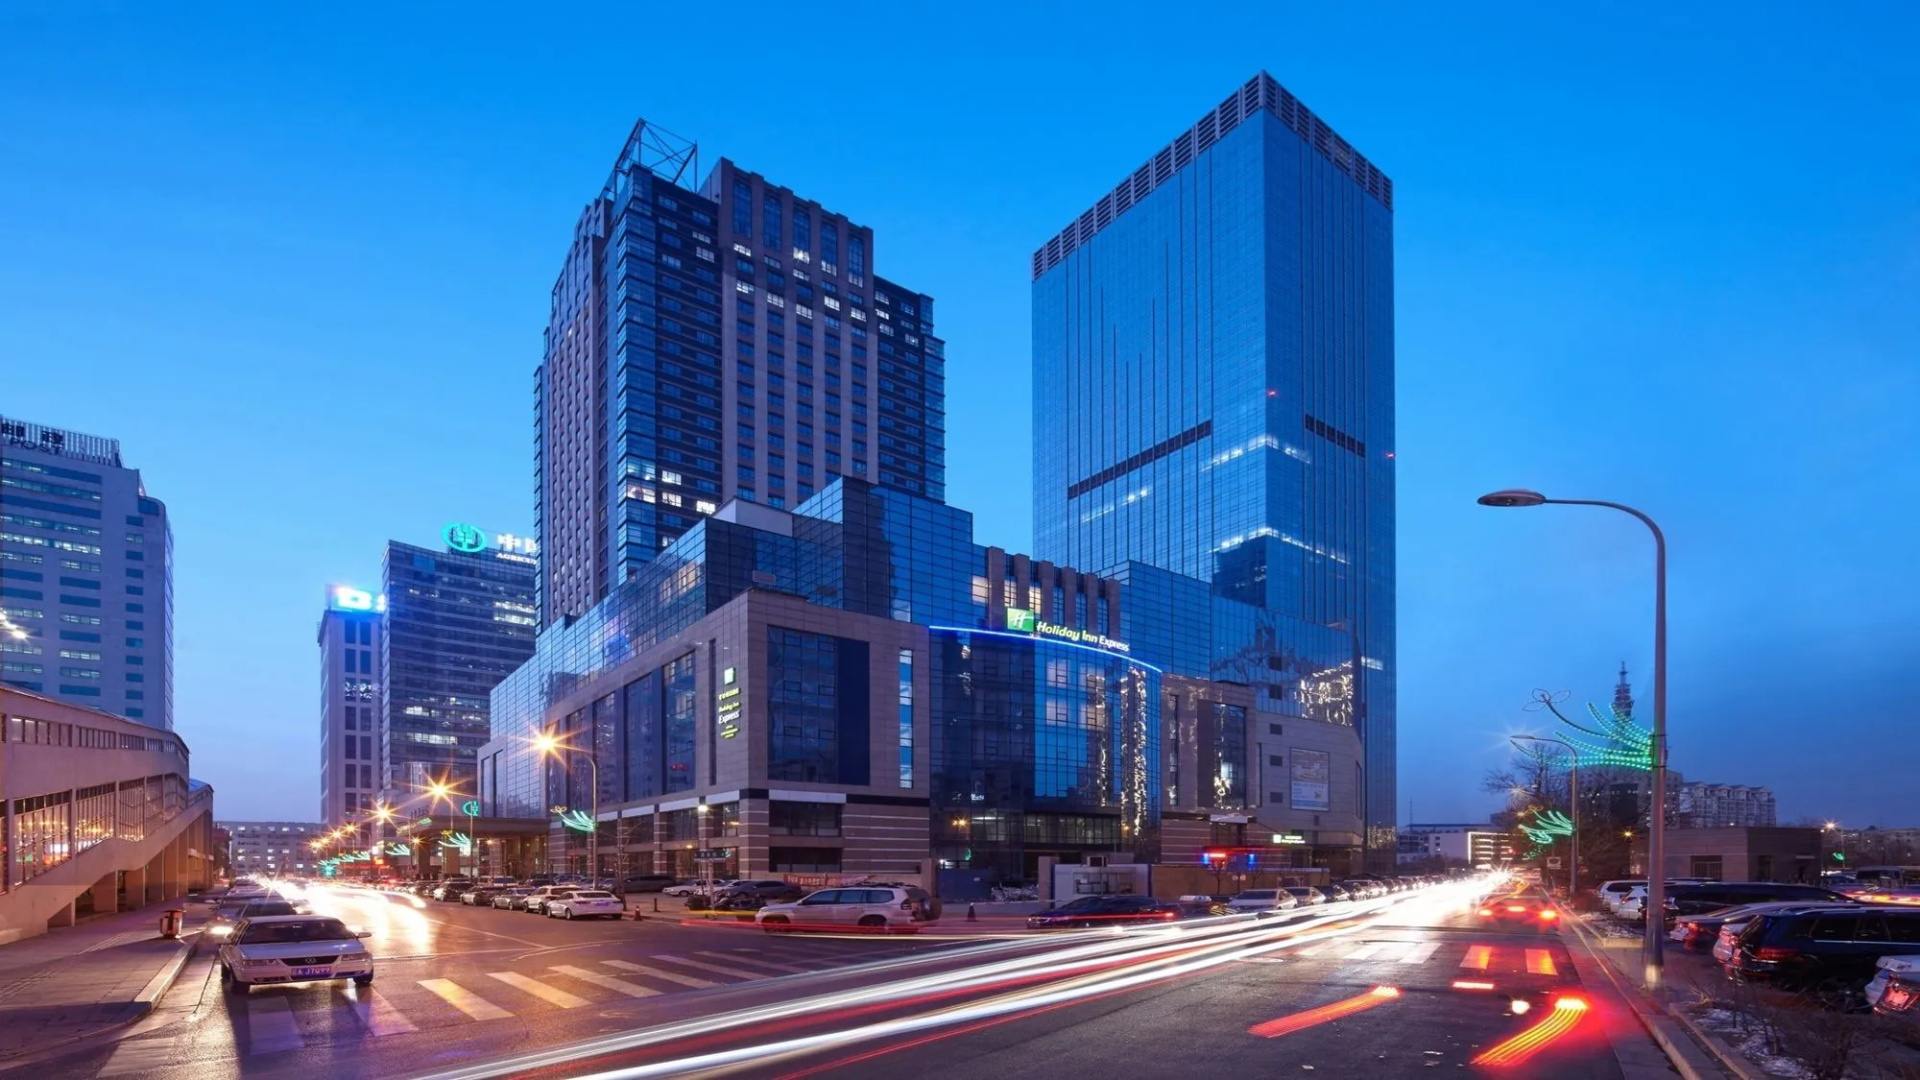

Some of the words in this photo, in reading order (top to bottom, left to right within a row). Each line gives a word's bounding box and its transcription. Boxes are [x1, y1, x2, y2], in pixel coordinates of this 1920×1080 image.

[1036, 621, 1080, 642] Holiday
[1082, 630, 1098, 643] Inn
[1099, 635, 1130, 652] Express
